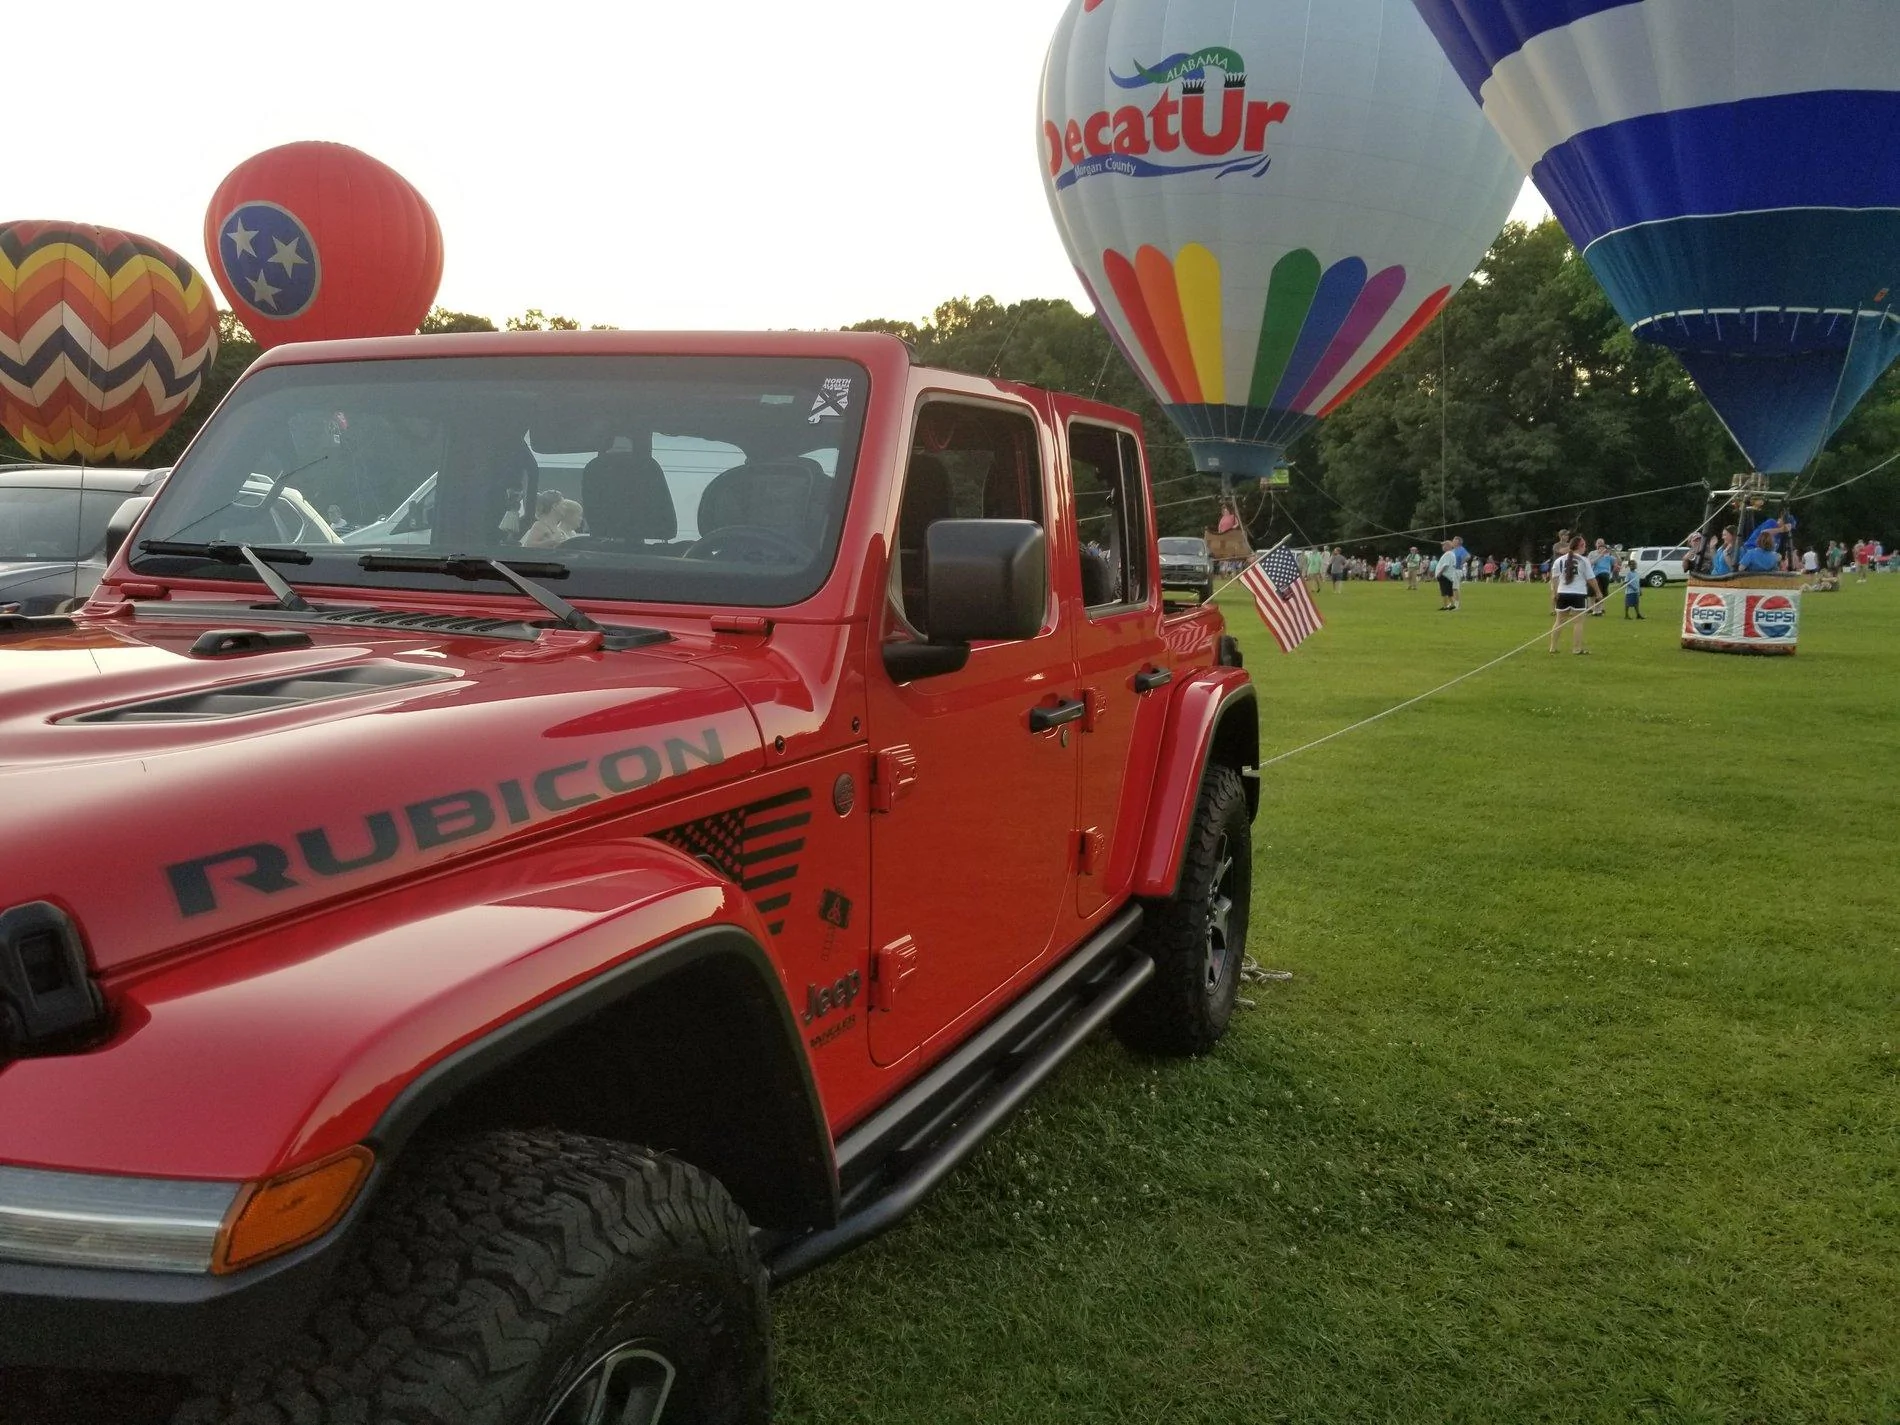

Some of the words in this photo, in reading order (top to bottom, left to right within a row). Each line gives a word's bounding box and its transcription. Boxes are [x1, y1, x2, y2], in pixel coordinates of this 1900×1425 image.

[1166, 53, 1228, 82] ALABAMA
[1074, 162, 1102, 179] Morgan
[1105, 157, 1137, 176] County
[1692, 608, 1725, 621] PEPSI
[1755, 611, 1795, 623] PEPSI
[165, 728, 727, 918] RUBICON
[800, 969, 861, 1027] Jeep
